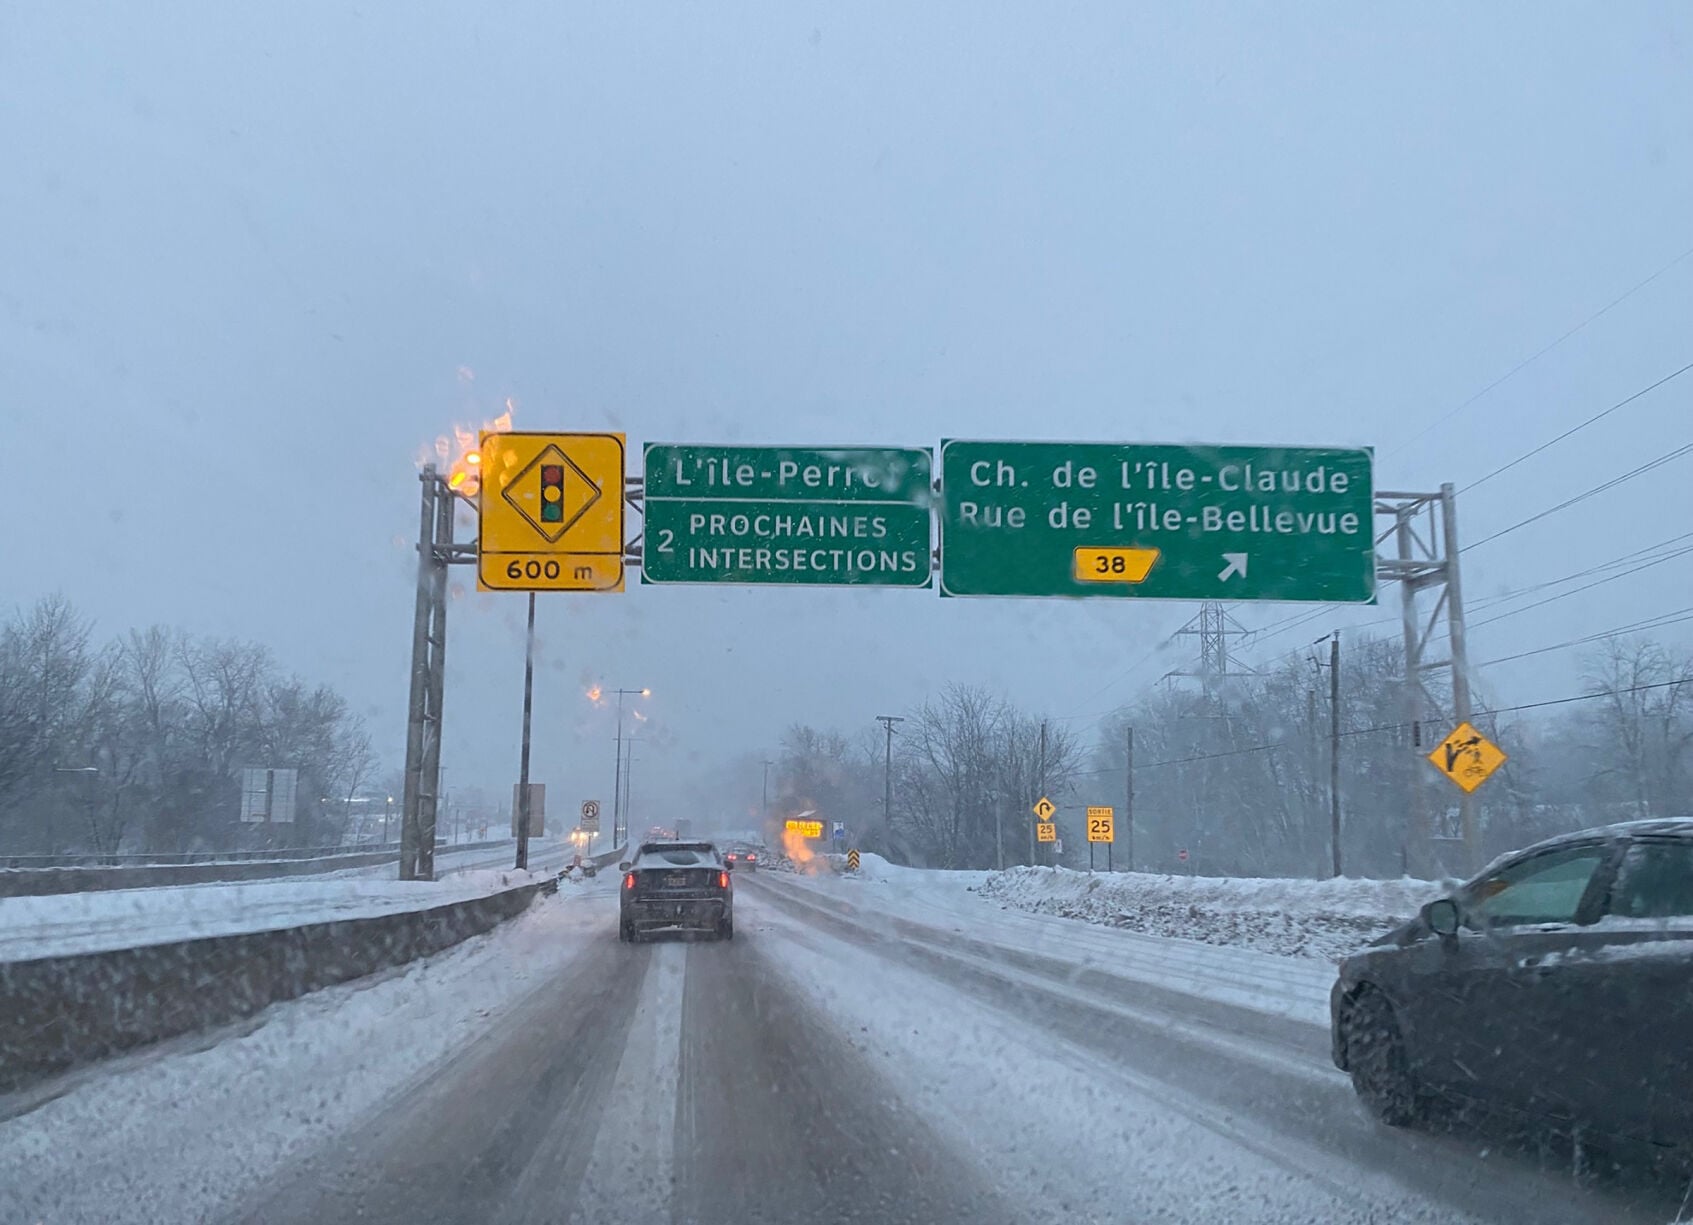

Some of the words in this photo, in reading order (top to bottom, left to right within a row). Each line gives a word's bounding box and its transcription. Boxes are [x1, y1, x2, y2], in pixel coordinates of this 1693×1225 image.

[676, 457, 897, 488] L'île-Perro
[970, 460, 1029, 487] Ch.
[1052, 460, 1098, 488] de
[690, 514, 887, 538] PROCHAINES
[959, 501, 1026, 528] Rue
[1049, 502, 1092, 529] de
[1113, 502, 1359, 534] l'île-Bellevue
[657, 529, 674, 552] 2
[506, 560, 560, 579] 600
[574, 566, 592, 580] m
[689, 547, 917, 571] INTERSECTIONS
[1095, 556, 1126, 574] 38
[1040, 825, 1053, 834] 25
[1091, 819, 1111, 834] 25
